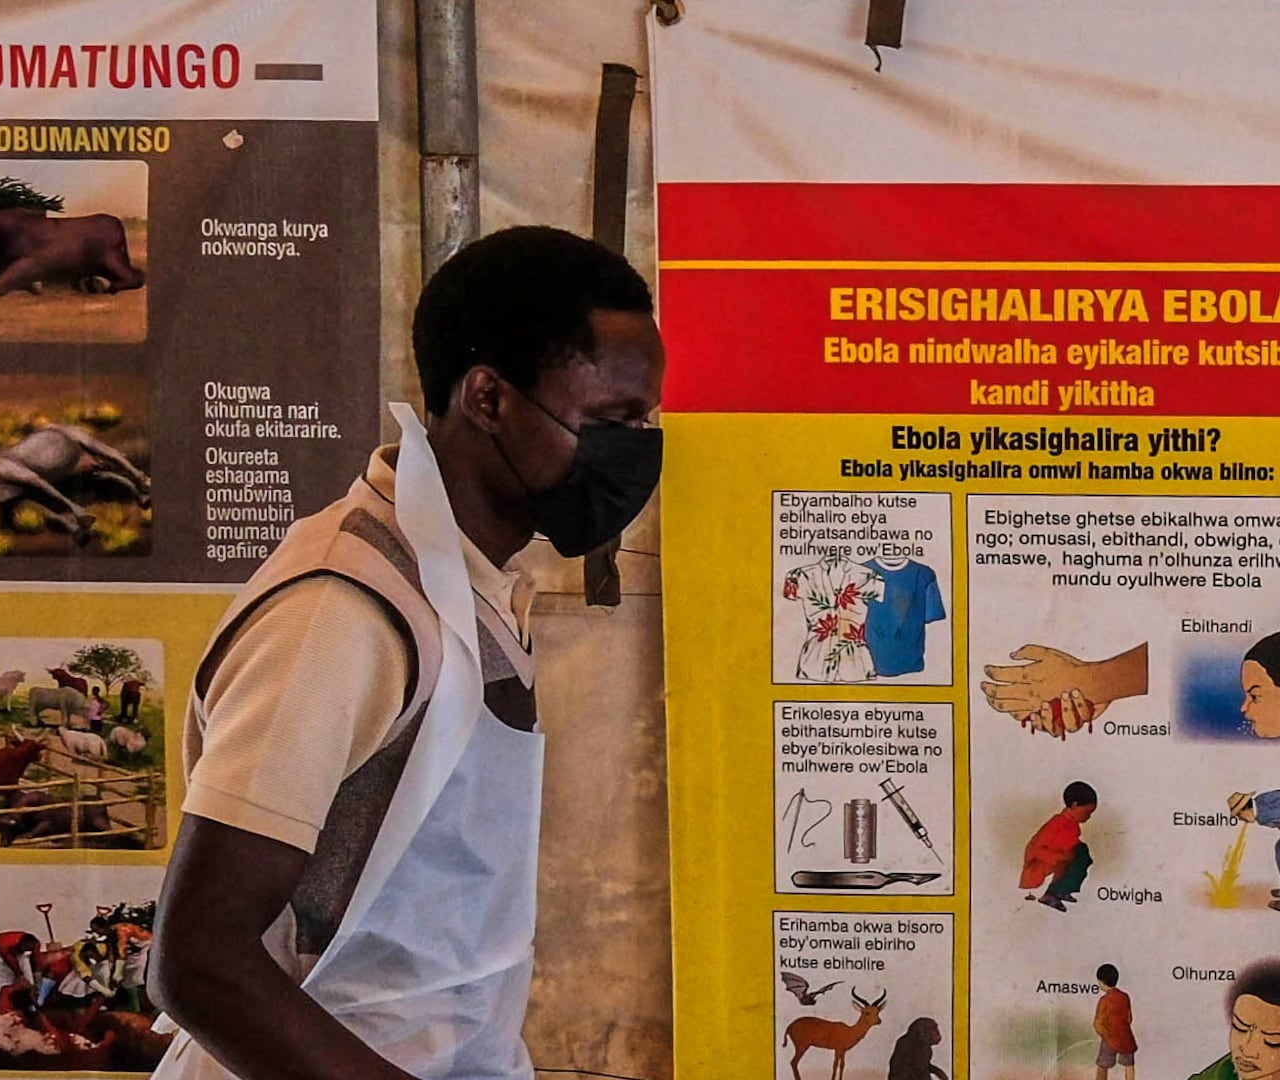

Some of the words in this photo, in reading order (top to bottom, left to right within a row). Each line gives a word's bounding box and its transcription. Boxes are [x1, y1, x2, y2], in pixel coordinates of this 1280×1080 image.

[200, 218, 277, 242] Okwanga
[282, 219, 329, 242] kurya
[201, 239, 301, 260] nokwonsya.
[829, 287, 1150, 322] ERISIGHALIRYA
[823, 337, 899, 363] Ebola
[908, 338, 1058, 364] nindwalha
[1066, 339, 1190, 372] eyikalire
[204, 381, 271, 405] Okugwa
[970, 379, 1049, 406] kandi
[1058, 381, 1155, 414] yikitha
[204, 401, 283, 419] kihumura
[287, 402, 319, 420] nari
[204, 420, 251, 438] okufa
[255, 421, 342, 439] ekitararire.
[892, 426, 961, 450] Ebola
[970, 426, 1139, 457] yikasighalira
[1147, 427, 1222, 457] yithi?
[204, 447, 279, 465] Okureeta
[205, 466, 290, 489] eshagama
[840, 460, 894, 478] Ebola
[899, 460, 1022, 484] yikasighalira
[1087, 461, 1155, 481] hamba
[1160, 462, 1208, 481] okwa
[779, 494, 873, 511] Ebyambalho
[877, 495, 917, 508] kutse
[206, 504, 295, 522] bwomubiri
[984, 510, 1071, 530] Ebighetse
[1075, 511, 1136, 530] ghetse
[1140, 511, 1229, 527] ebikalhwa
[1051, 572, 1112, 587] mundu
[1116, 572, 1207, 591] oyulhwere
[1211, 573, 1262, 588] Ebola
[1181, 618, 1253, 634] Ebithandi
[781, 706, 860, 724] Erikolesya
[864, 707, 924, 725] ebyuma
[1103, 721, 1171, 736] Omusasi
[1172, 812, 1239, 826] Ebisalho
[1096, 887, 1163, 906] Obwigha
[779, 918, 849, 933] Erihamba
[853, 919, 893, 933] okwa
[897, 919, 944, 934] bisoro
[1172, 966, 1236, 981] Olhunza
[1036, 980, 1100, 994] Amaswe
